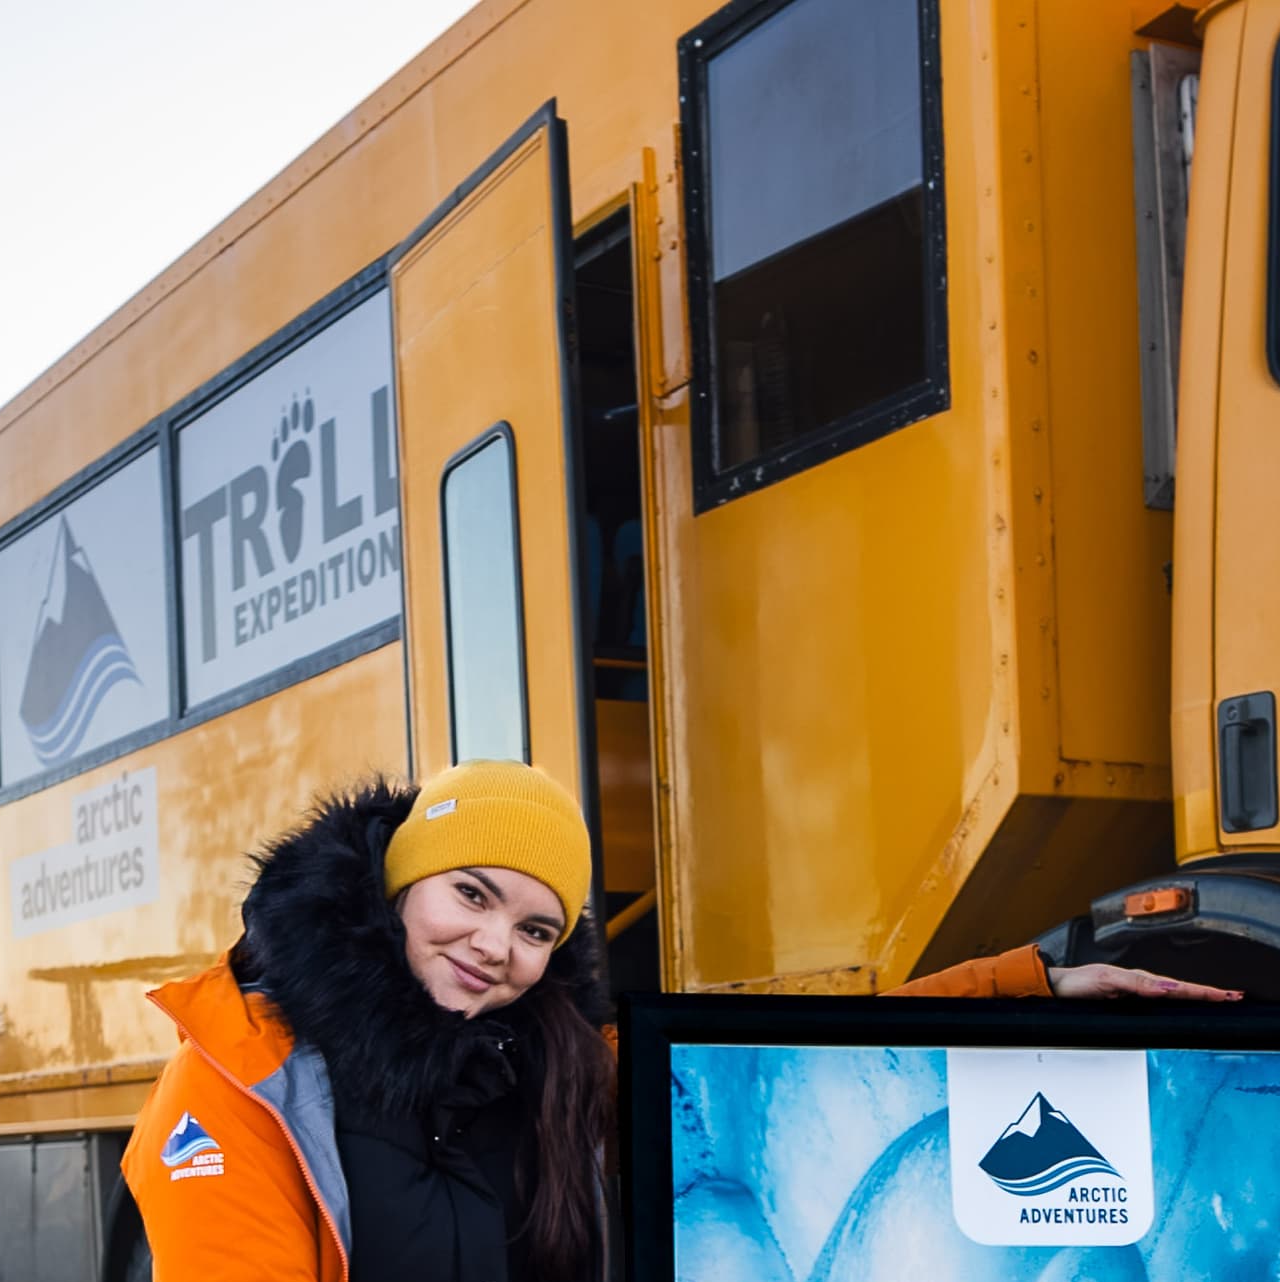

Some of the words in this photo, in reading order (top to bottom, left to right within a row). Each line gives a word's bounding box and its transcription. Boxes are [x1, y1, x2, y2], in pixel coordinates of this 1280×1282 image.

[77, 770, 143, 844] arctic
[22, 846, 145, 920] adventures
[1019, 1208, 1129, 1224] ADVENTURES
[1068, 1187, 1128, 1203] ARCTIC
